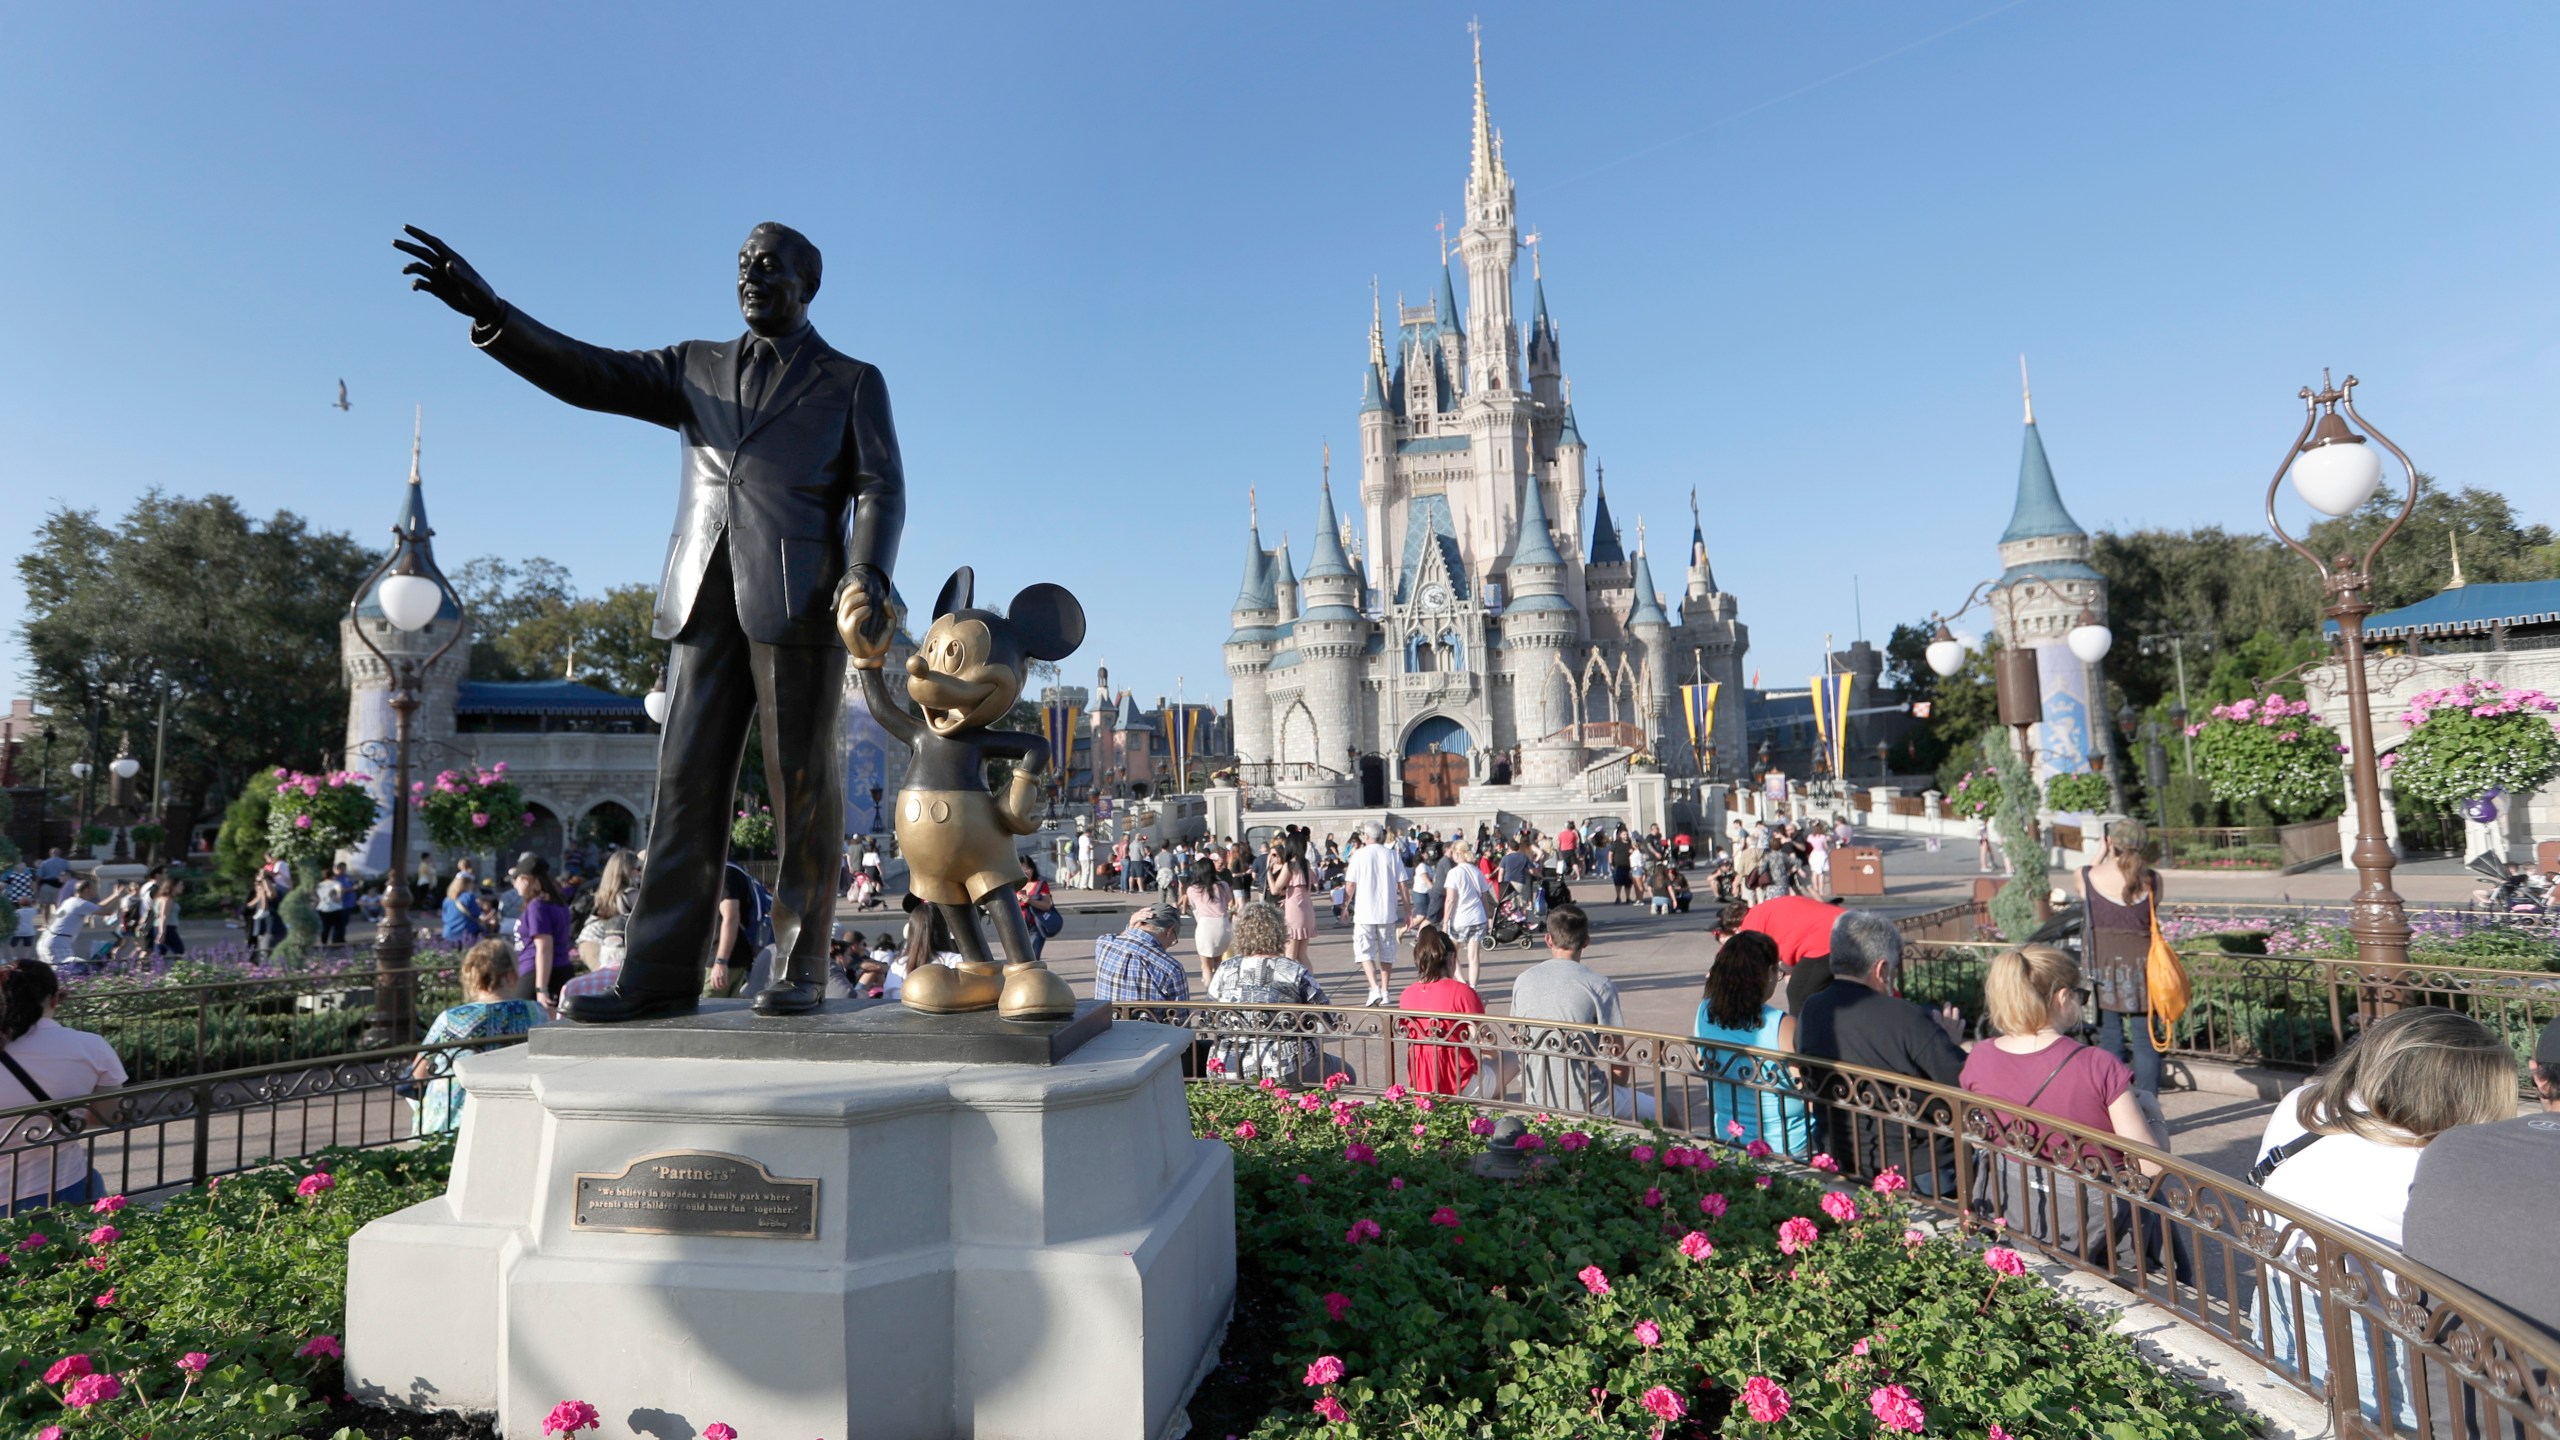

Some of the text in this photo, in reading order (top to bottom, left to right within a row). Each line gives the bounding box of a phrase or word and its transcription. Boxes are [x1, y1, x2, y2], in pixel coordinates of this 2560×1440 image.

[652, 1165, 737, 1181] "Partners"
[616, 1187, 647, 1198] believe
[648, 1188, 658, 1198] in
[709, 1191, 737, 1201] family
[740, 1192, 760, 1202] park
[763, 1193, 791, 1202] where
[589, 1199, 621, 1209] parents
[623, 1200, 640, 1209] and
[641, 1201, 678, 1210] children
[681, 1202, 705, 1211] could
[708, 1203, 728, 1212] have
[730, 1204, 746, 1212] fun
